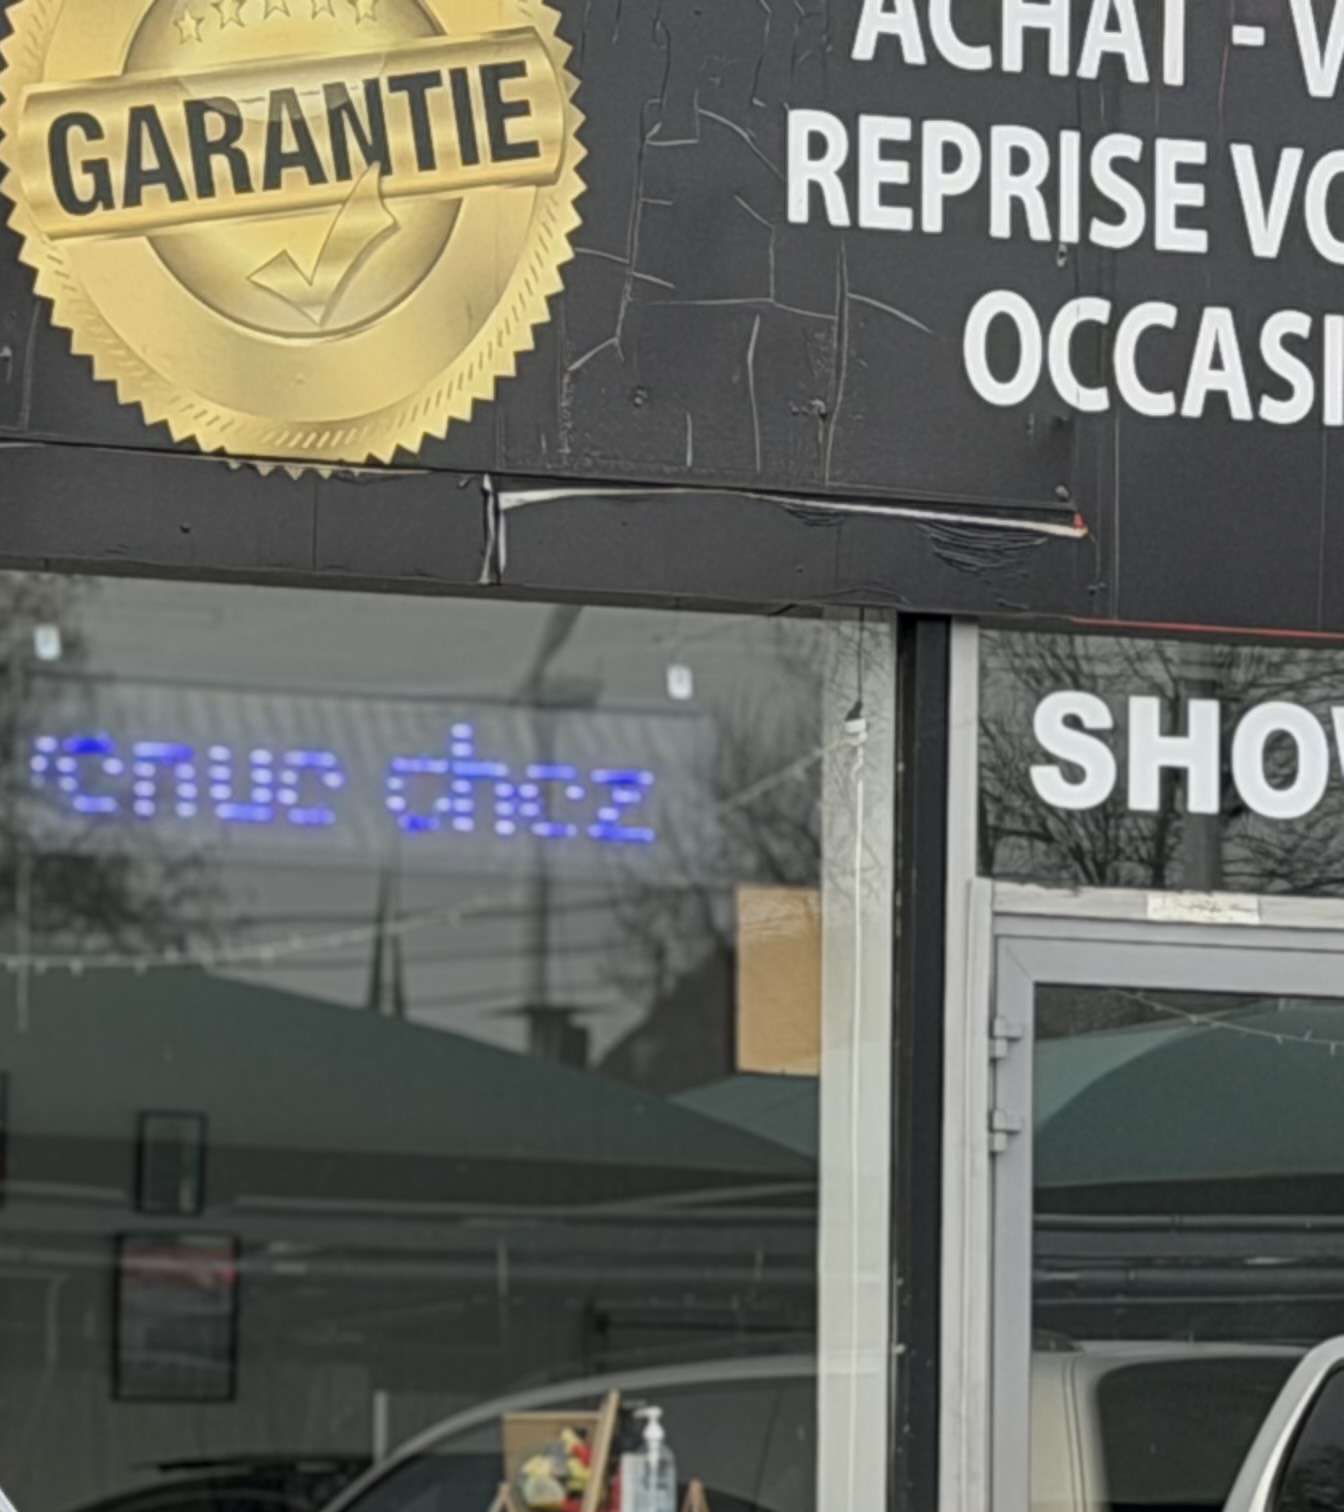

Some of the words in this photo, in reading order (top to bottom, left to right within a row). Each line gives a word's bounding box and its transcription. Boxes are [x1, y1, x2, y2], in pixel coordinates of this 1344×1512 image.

[47, 59, 540, 216] GARANTIE
[786, 108, 1209, 254] REPRISE
[1028, 689, 1344, 820] SHO
